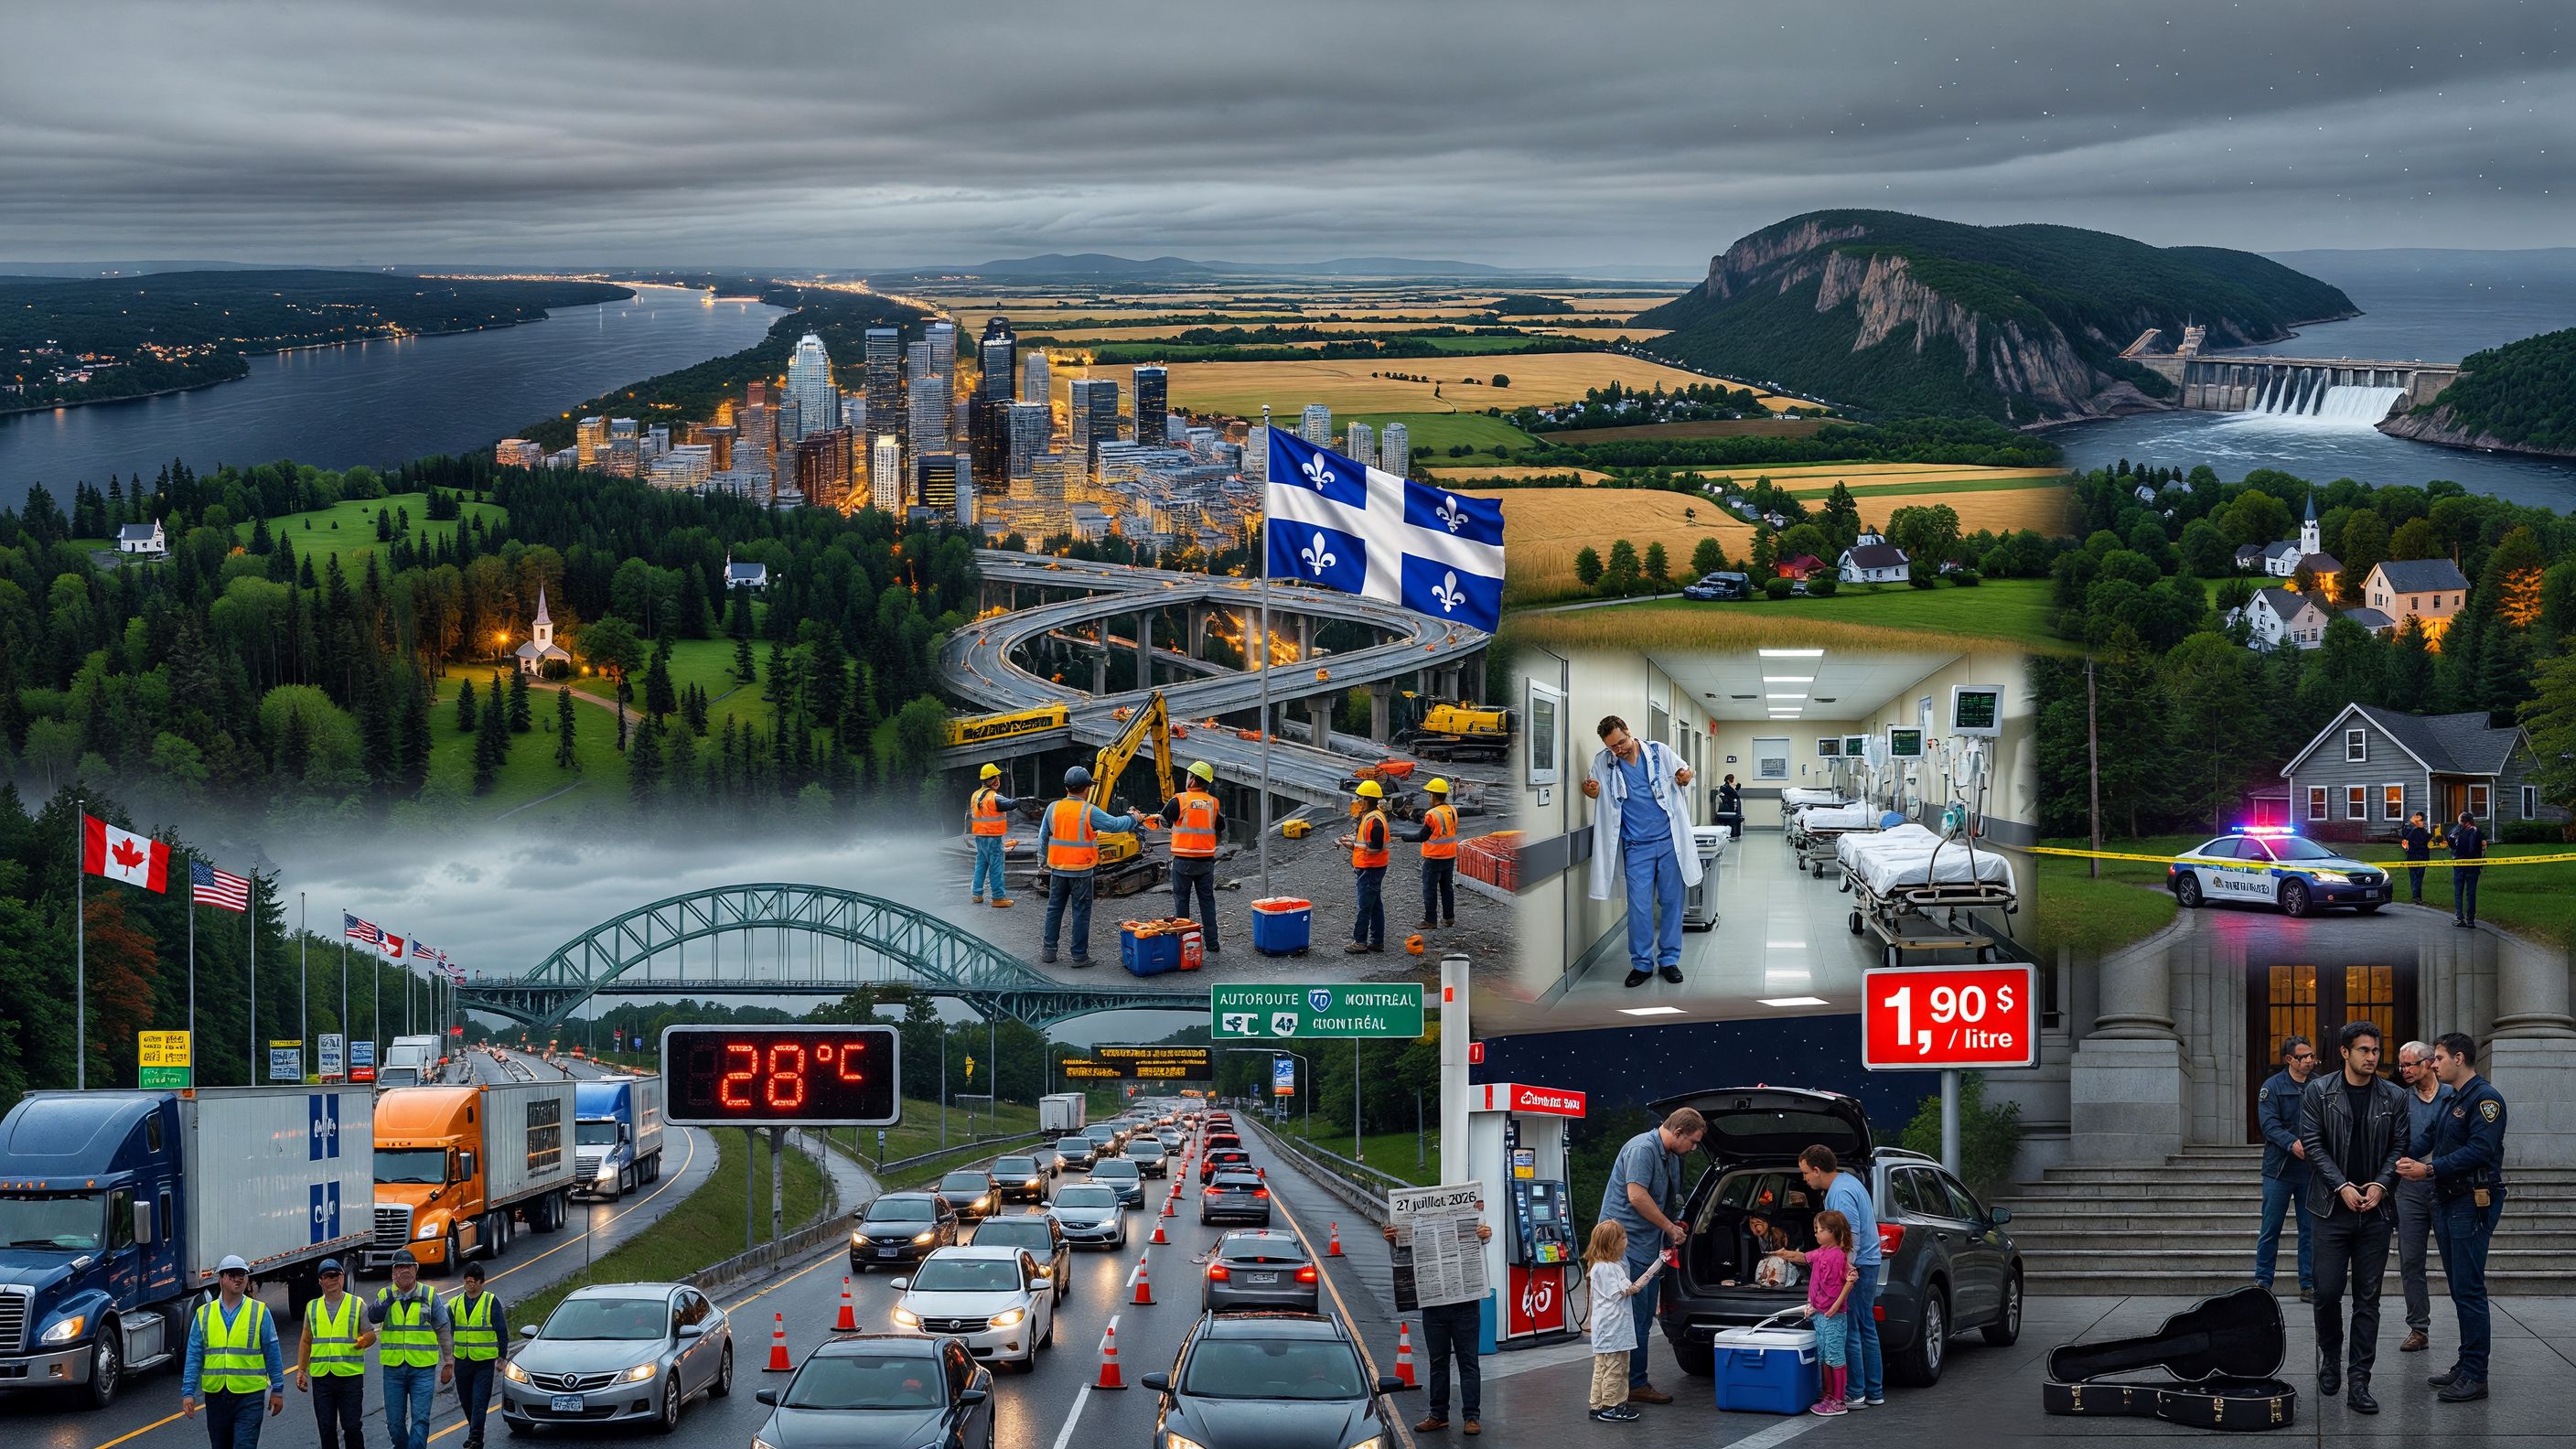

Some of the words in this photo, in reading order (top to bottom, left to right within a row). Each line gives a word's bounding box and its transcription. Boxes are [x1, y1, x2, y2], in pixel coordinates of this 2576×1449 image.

[1219, 993, 1299, 1005] AUTOROUTE
[1996, 984, 2014, 1014] $
[1965, 1028, 2013, 1049] litre
[1396, 1198, 1410, 1211] 27
[1448, 1191, 1476, 1206] 2026
